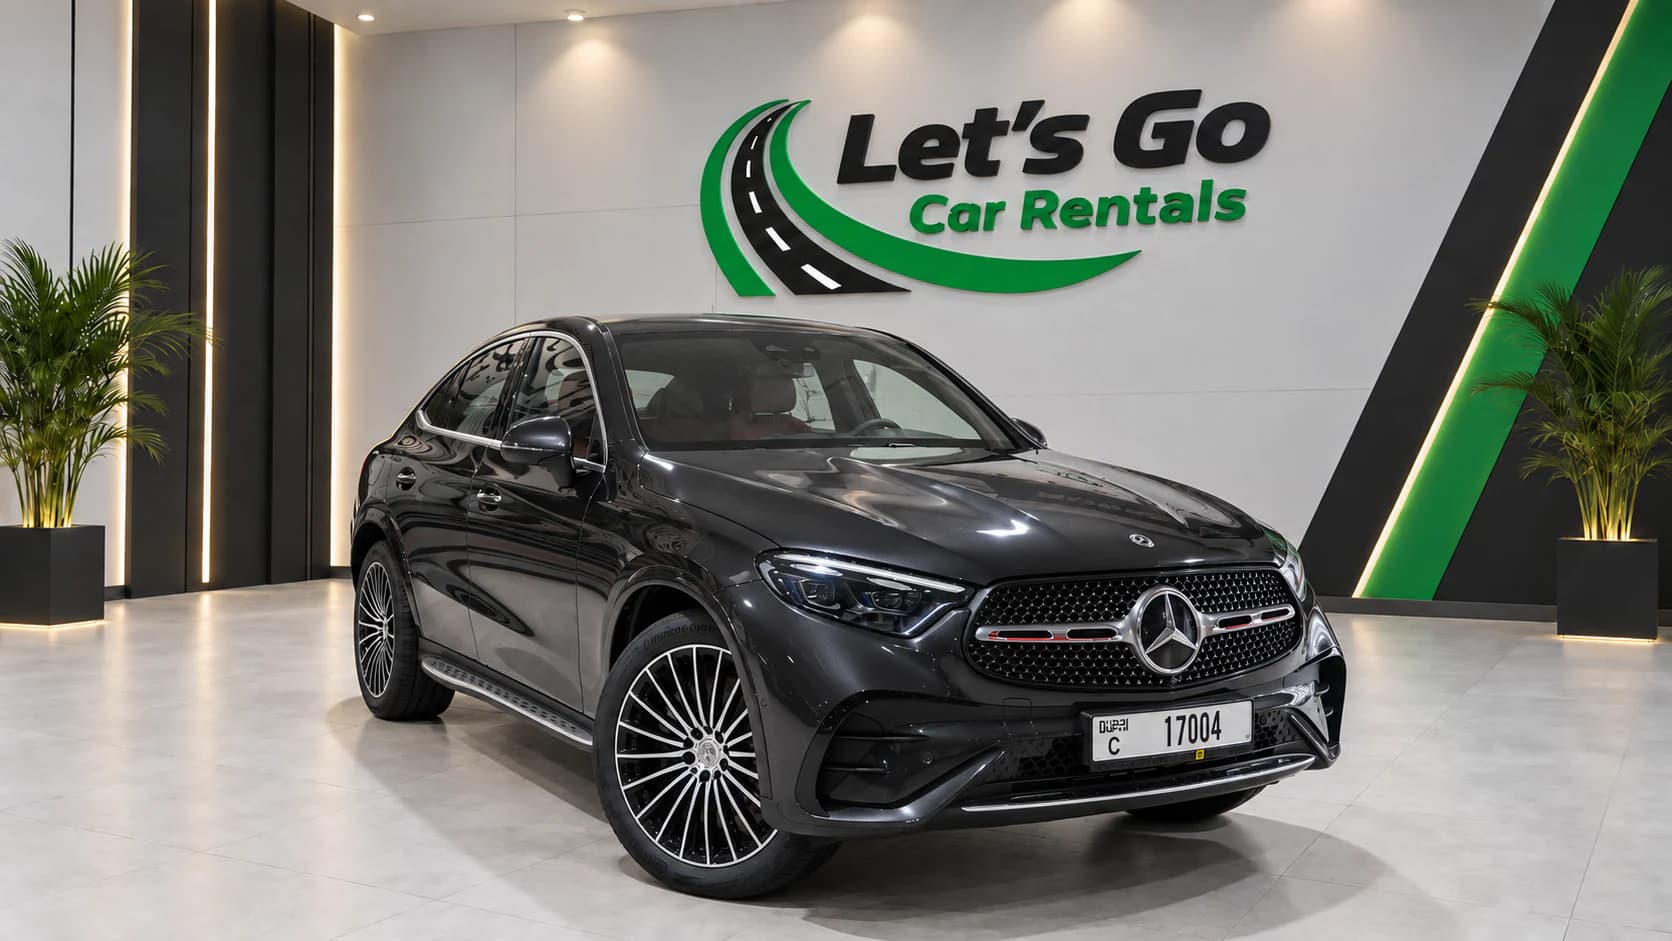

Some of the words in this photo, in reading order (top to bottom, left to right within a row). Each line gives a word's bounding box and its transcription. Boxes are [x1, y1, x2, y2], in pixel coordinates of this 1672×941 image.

[836, 99, 1090, 185] Let's
[1113, 88, 1271, 170] Go
[908, 193, 1008, 235] Car
[1019, 178, 1247, 230] Rentals
[1108, 736, 1120, 755] C
[1165, 710, 1222, 747] 17004
